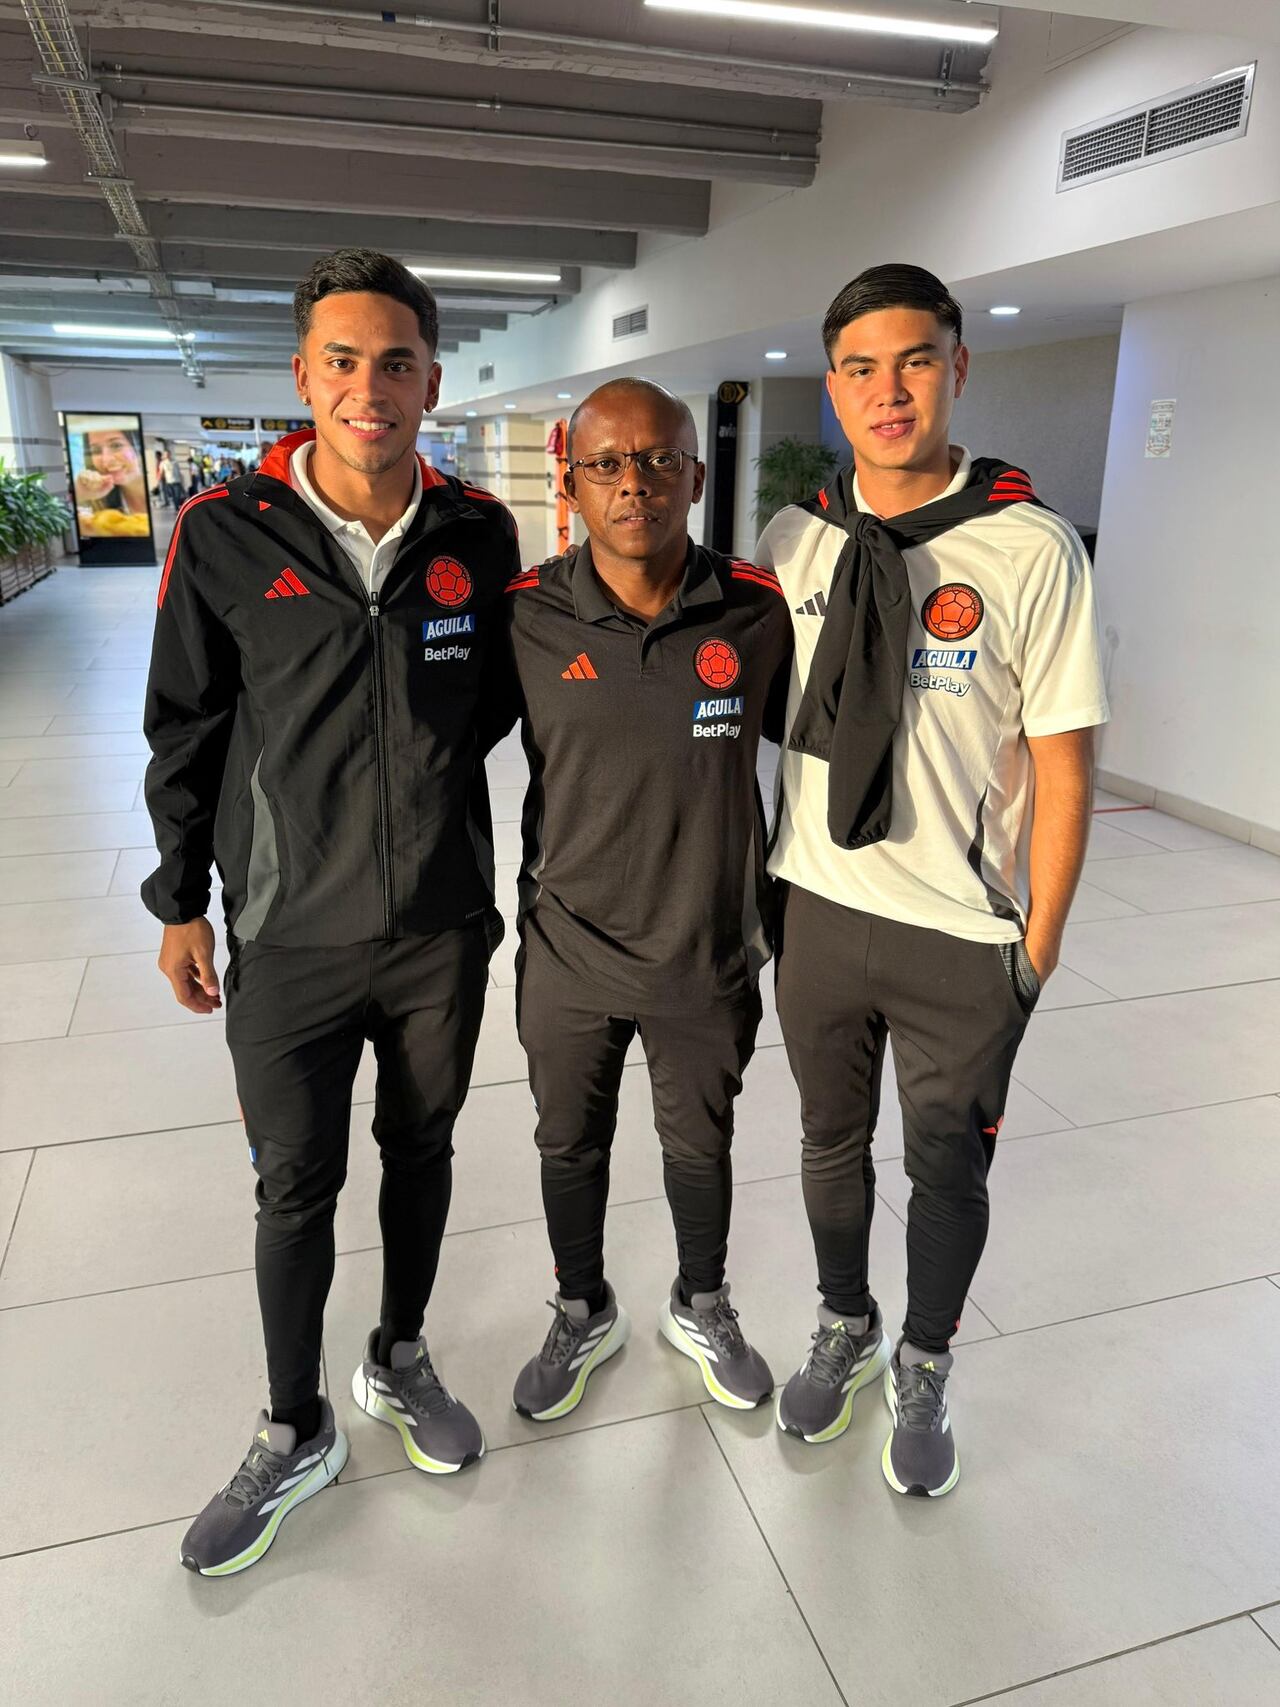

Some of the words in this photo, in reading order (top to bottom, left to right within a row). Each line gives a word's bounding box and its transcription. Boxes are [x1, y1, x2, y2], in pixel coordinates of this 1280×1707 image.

[425, 615, 472, 640] AGUILA
[424, 645, 471, 661] BetPlay
[915, 650, 971, 668] AGUILA
[910, 673, 970, 697] BetPlay
[695, 697, 741, 719] AGUILA
[693, 722, 741, 739] BetPlay
